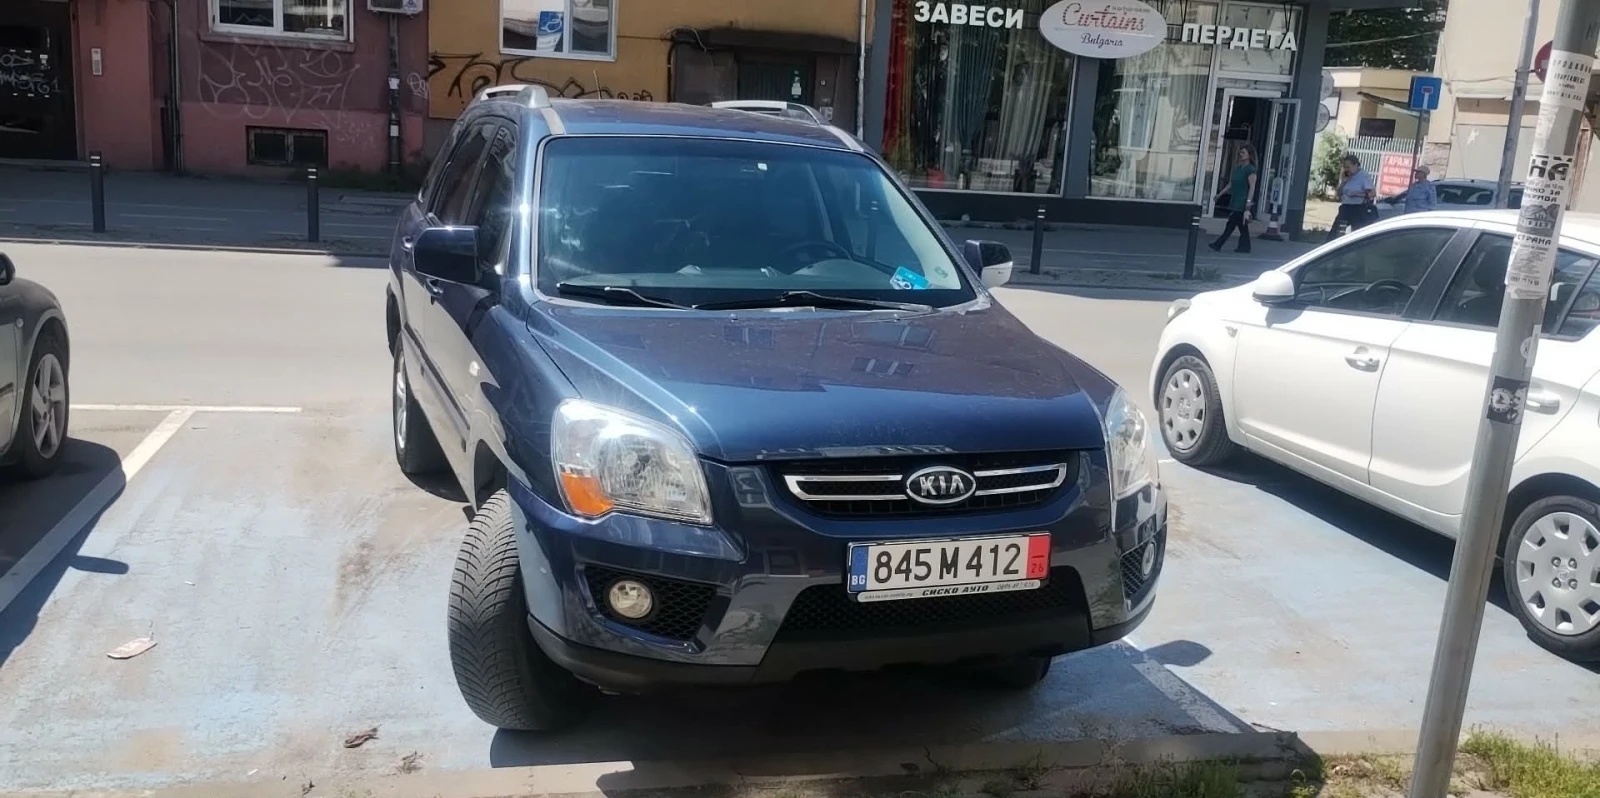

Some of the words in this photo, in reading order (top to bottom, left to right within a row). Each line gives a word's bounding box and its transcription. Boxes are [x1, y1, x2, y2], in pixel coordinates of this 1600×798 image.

[914, 0, 1024, 29] ЗАВЕСИ
[1062, 2, 1145, 31] Curtains
[1081, 32, 1123, 48] Bulgaria
[1181, 22, 1298, 51] ПЕРДЕТА
[920, 474, 966, 496] KIA
[1031, 563, 1044, 574] 26
[851, 575, 866, 585] BG
